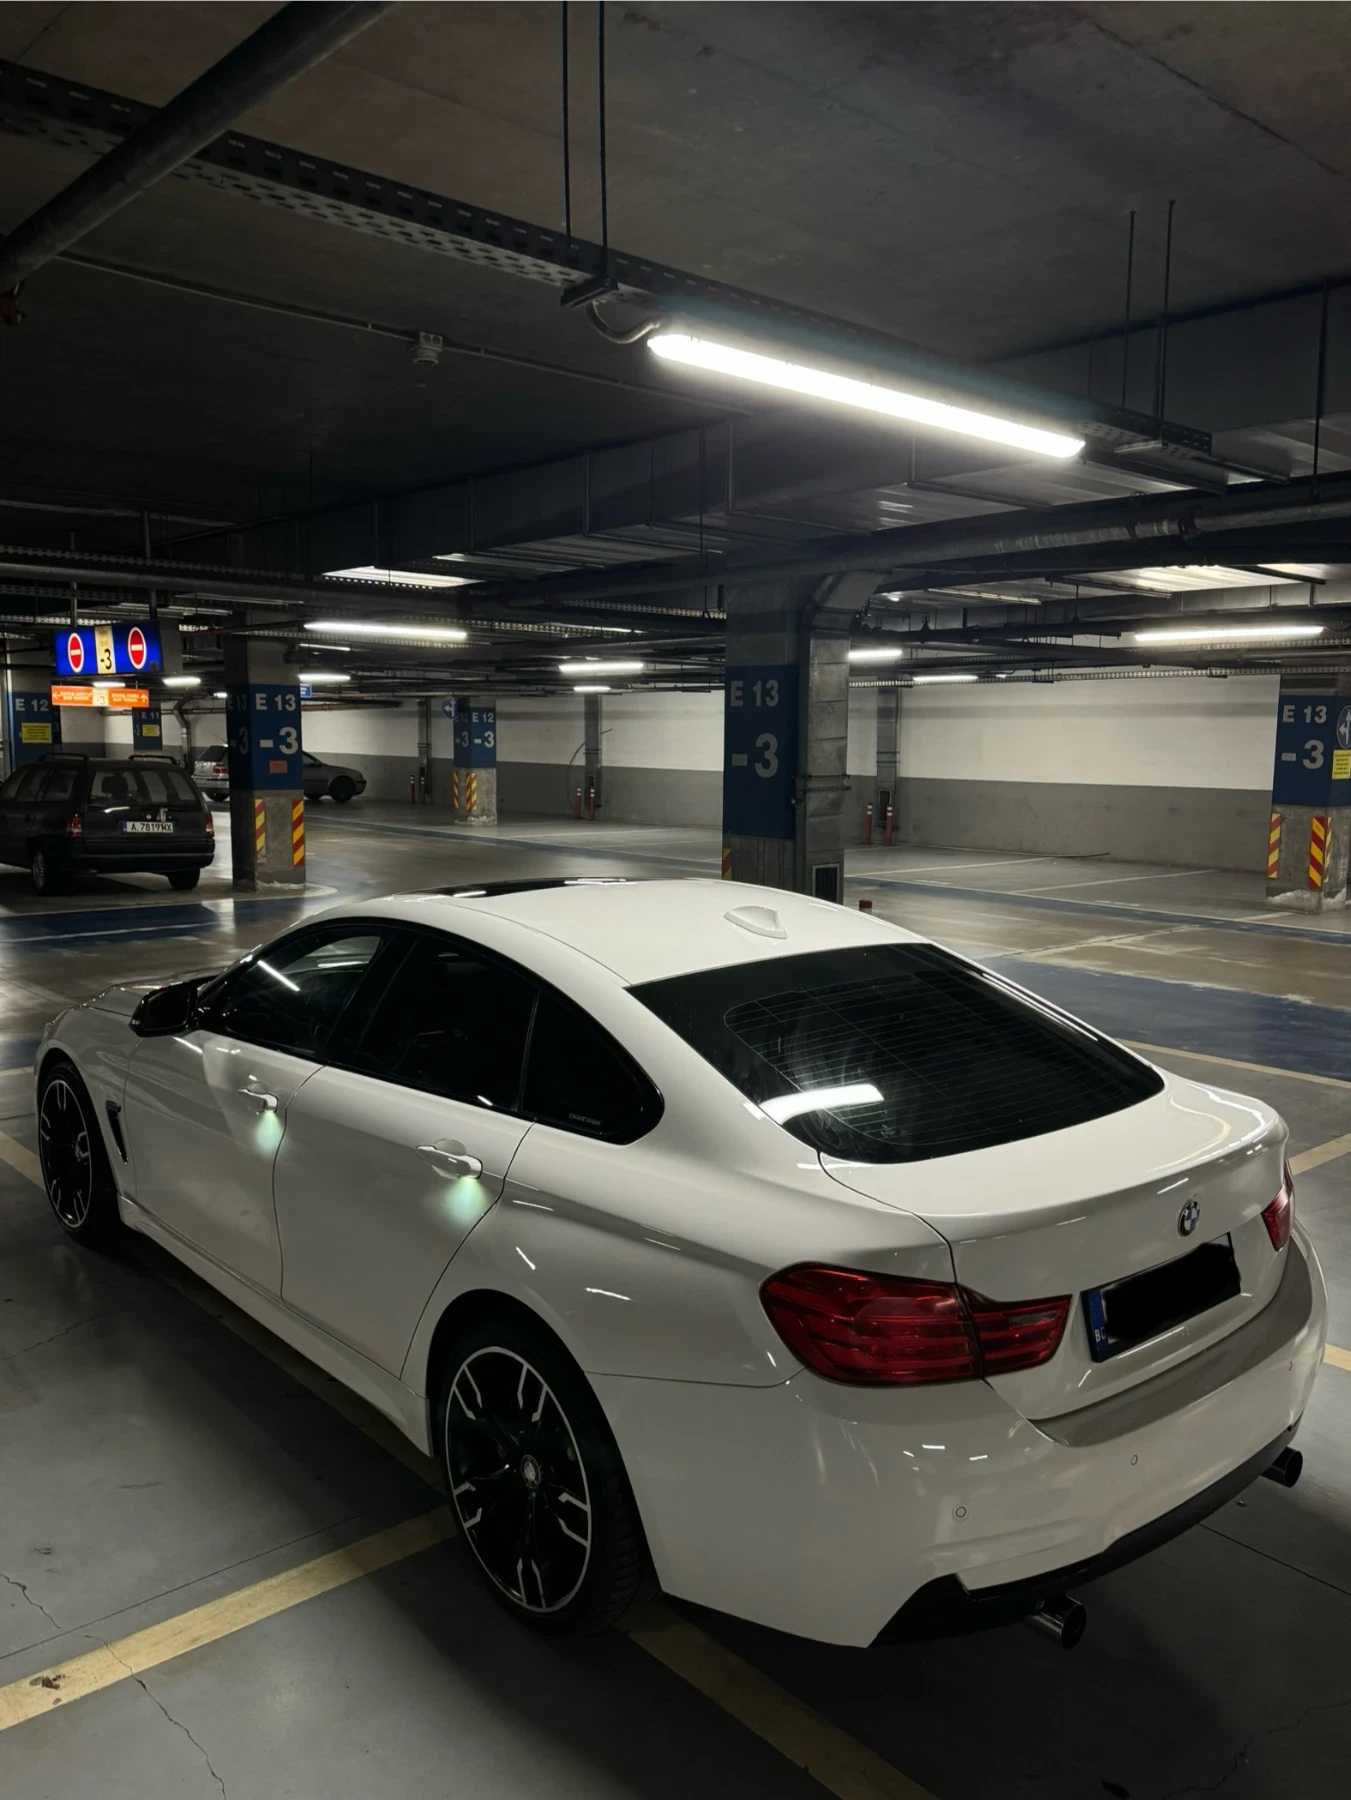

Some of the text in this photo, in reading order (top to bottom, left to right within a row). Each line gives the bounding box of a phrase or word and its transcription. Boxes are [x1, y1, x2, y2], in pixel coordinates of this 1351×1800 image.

[100, 648, 112, 670] -3
[255, 692, 297, 712] E 13
[730, 679, 779, 707] E 13
[15, 698, 49, 712] E 12
[1282, 704, 1328, 724] E 13
[472, 712, 495, 723] E 12
[260, 726, 298, 755] -3
[473, 731, 495, 748] -3
[731, 732, 780, 778] -3
[1281, 739, 1325, 770] -3
